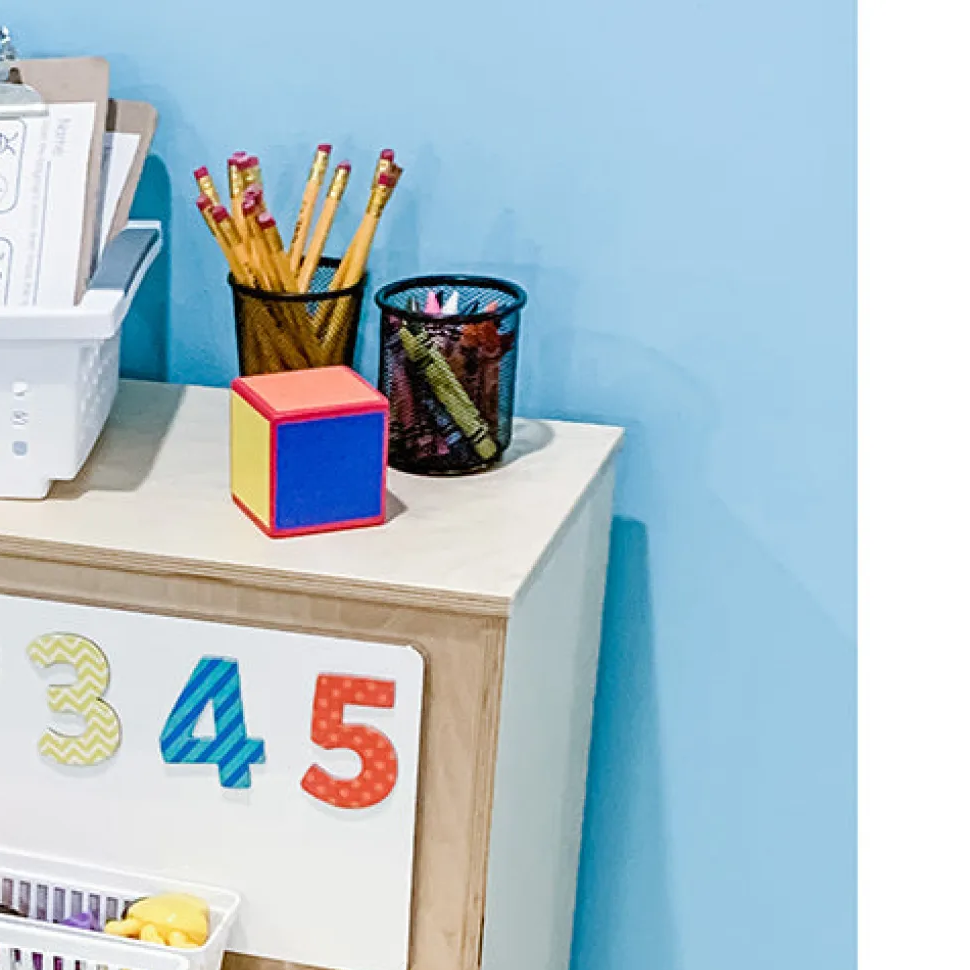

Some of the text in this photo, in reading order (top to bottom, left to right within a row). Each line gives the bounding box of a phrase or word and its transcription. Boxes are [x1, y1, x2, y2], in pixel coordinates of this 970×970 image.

[28, 632, 123, 767] 3
[159, 656, 266, 790] 4
[300, 671, 400, 810] 5
